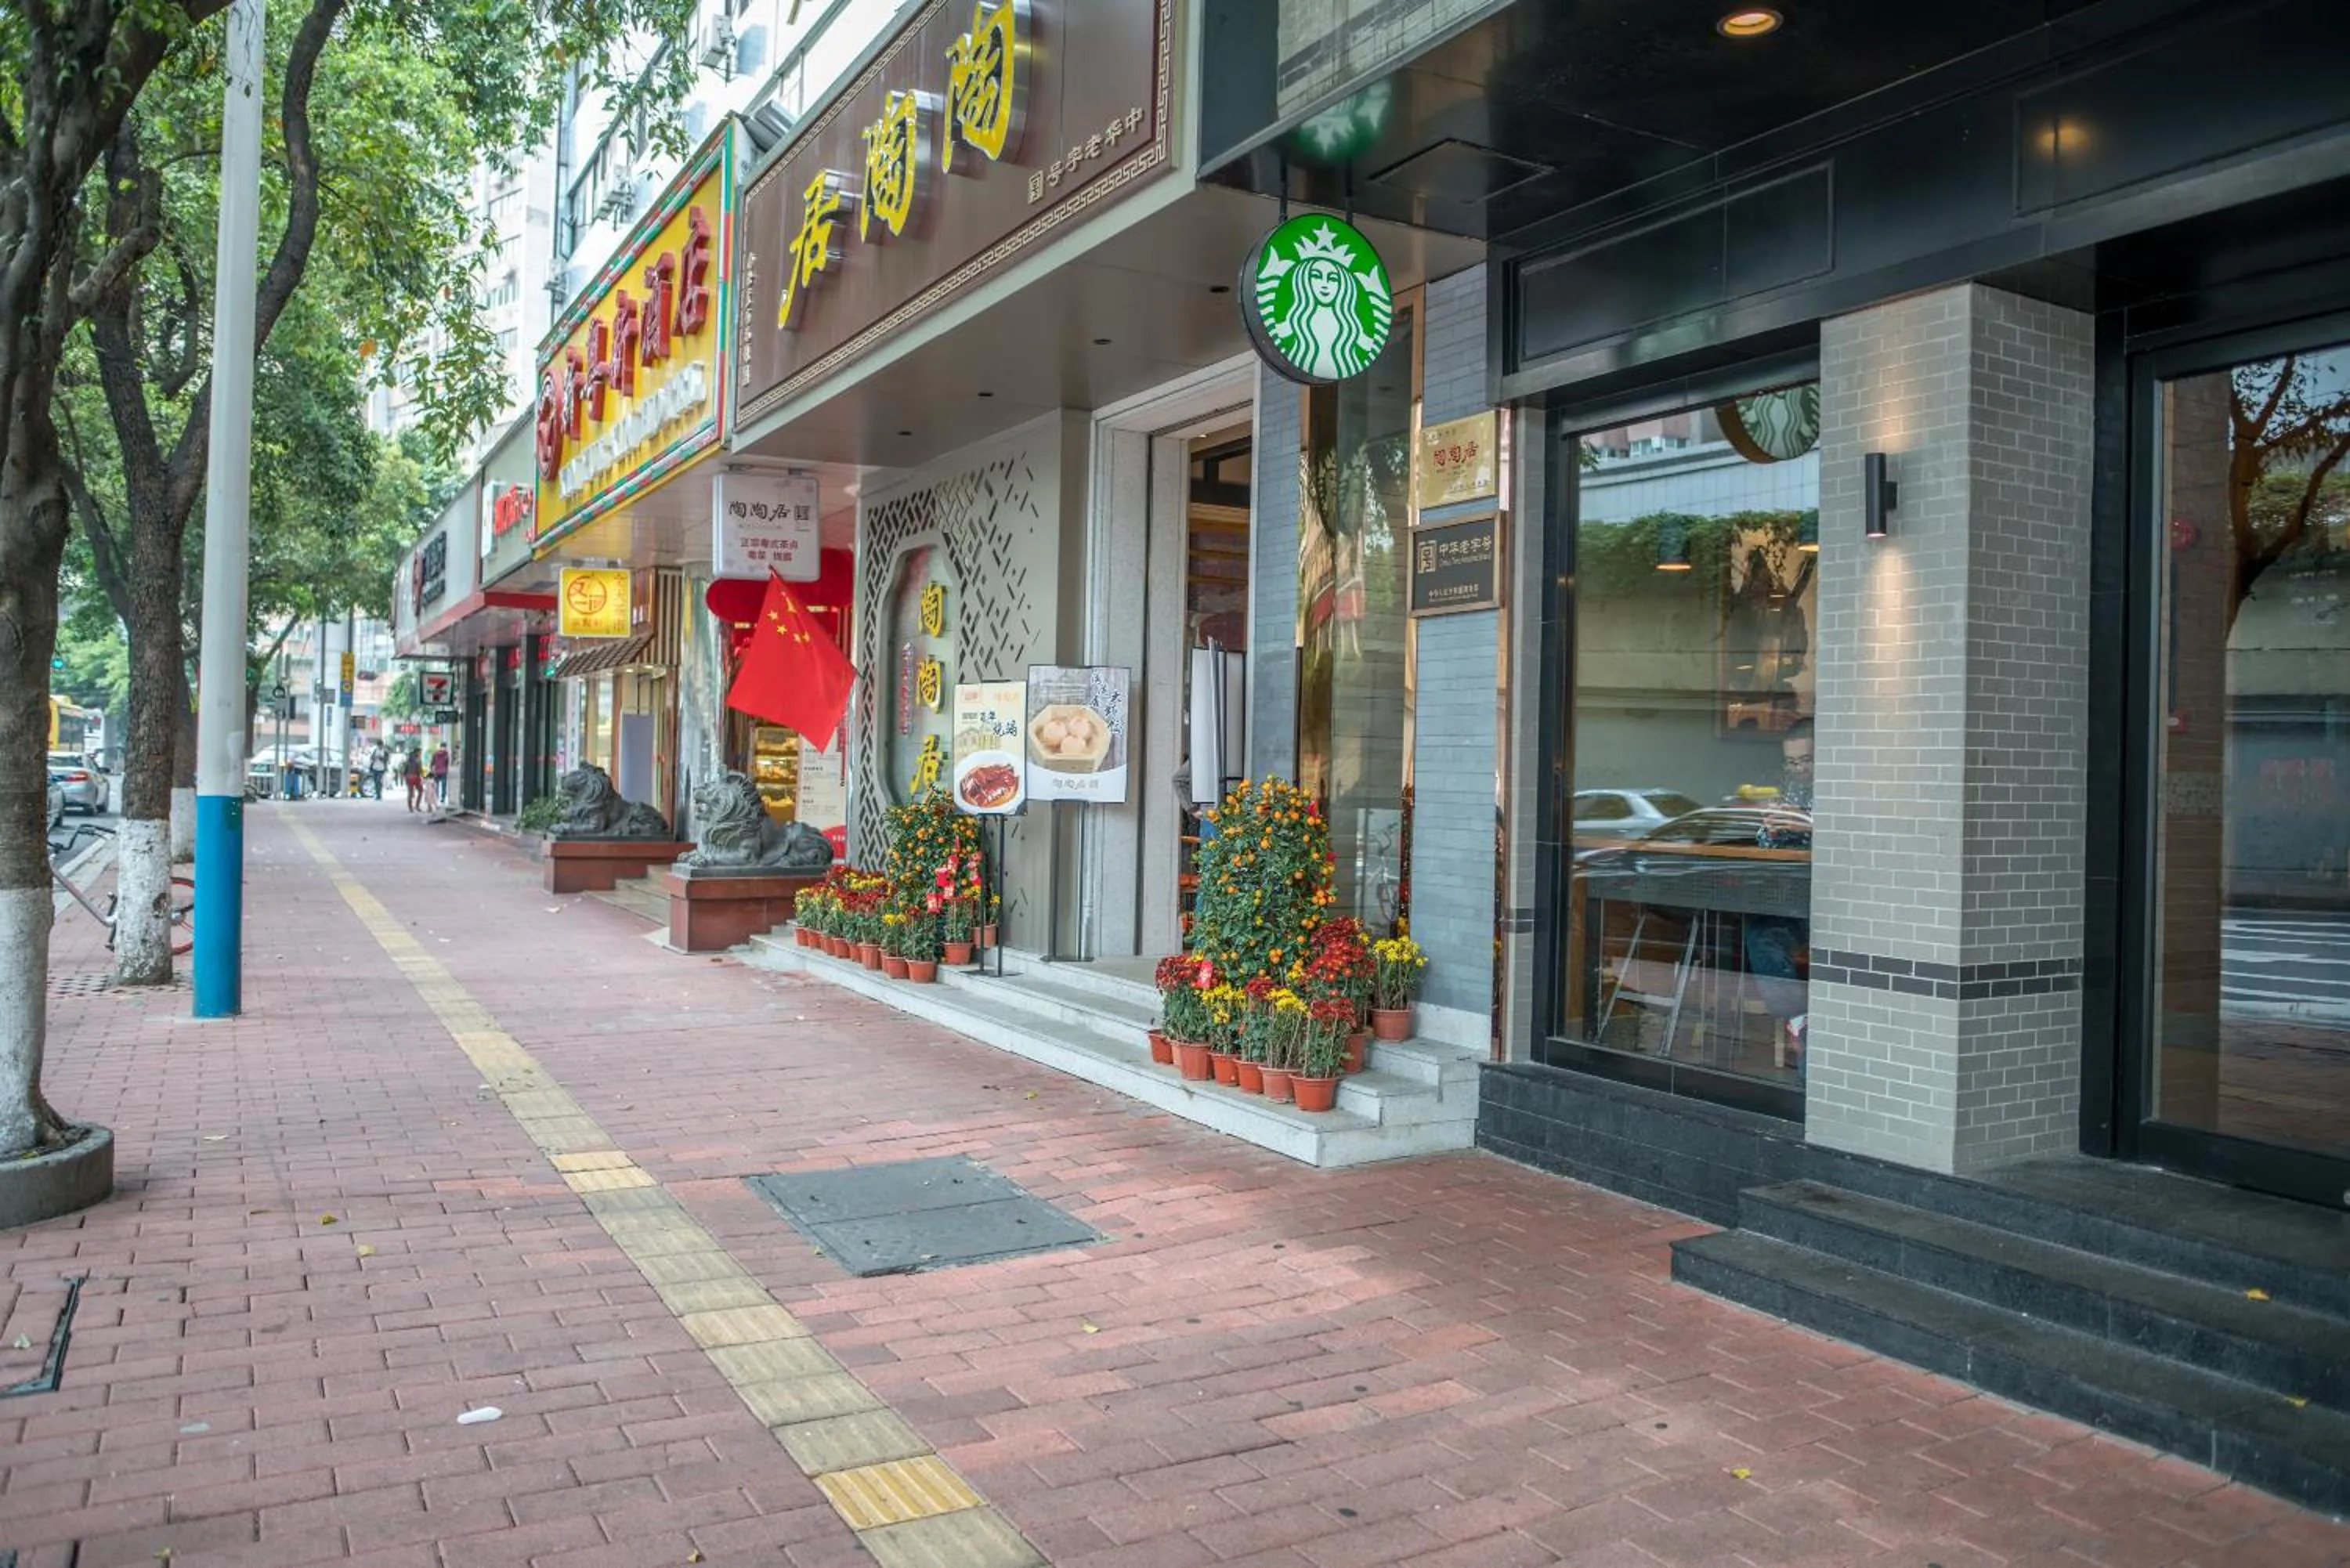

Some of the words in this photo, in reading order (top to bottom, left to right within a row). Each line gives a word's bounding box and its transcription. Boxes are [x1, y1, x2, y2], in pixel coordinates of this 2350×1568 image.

[728, 500, 790, 522] 陶陶居
[1439, 535, 1492, 558] 中华老字号
[909, 580, 945, 795] 陶陶居
